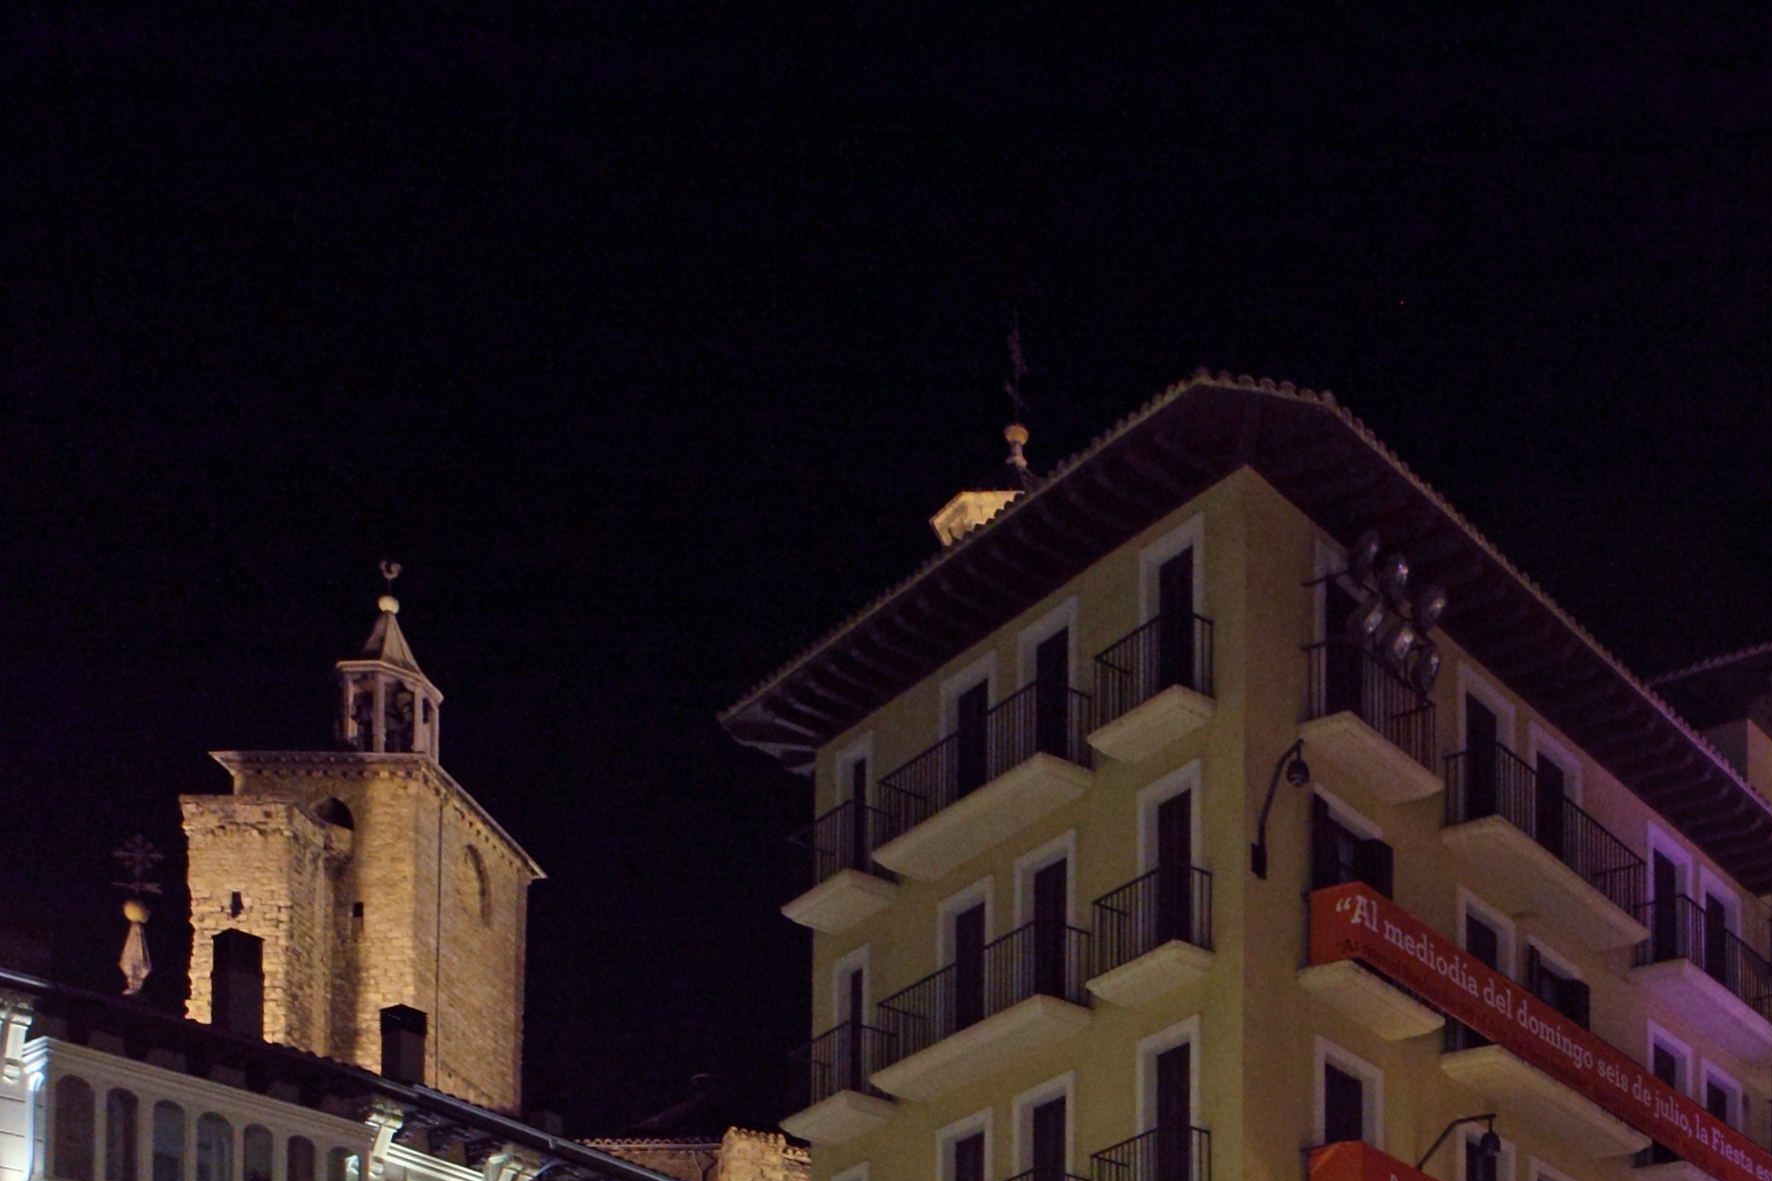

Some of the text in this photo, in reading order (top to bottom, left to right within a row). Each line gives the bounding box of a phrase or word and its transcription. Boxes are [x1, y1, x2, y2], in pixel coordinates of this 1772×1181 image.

[1384, 919, 1479, 998] mediodía
[1483, 977, 1512, 1019] del
[1517, 1000, 1594, 1070] domingo
[1597, 1059, 1629, 1092] seis
[1632, 1075, 1652, 1107] de
[1695, 1113, 1709, 1146] la
[1711, 1126, 1754, 1175] Fiesta
